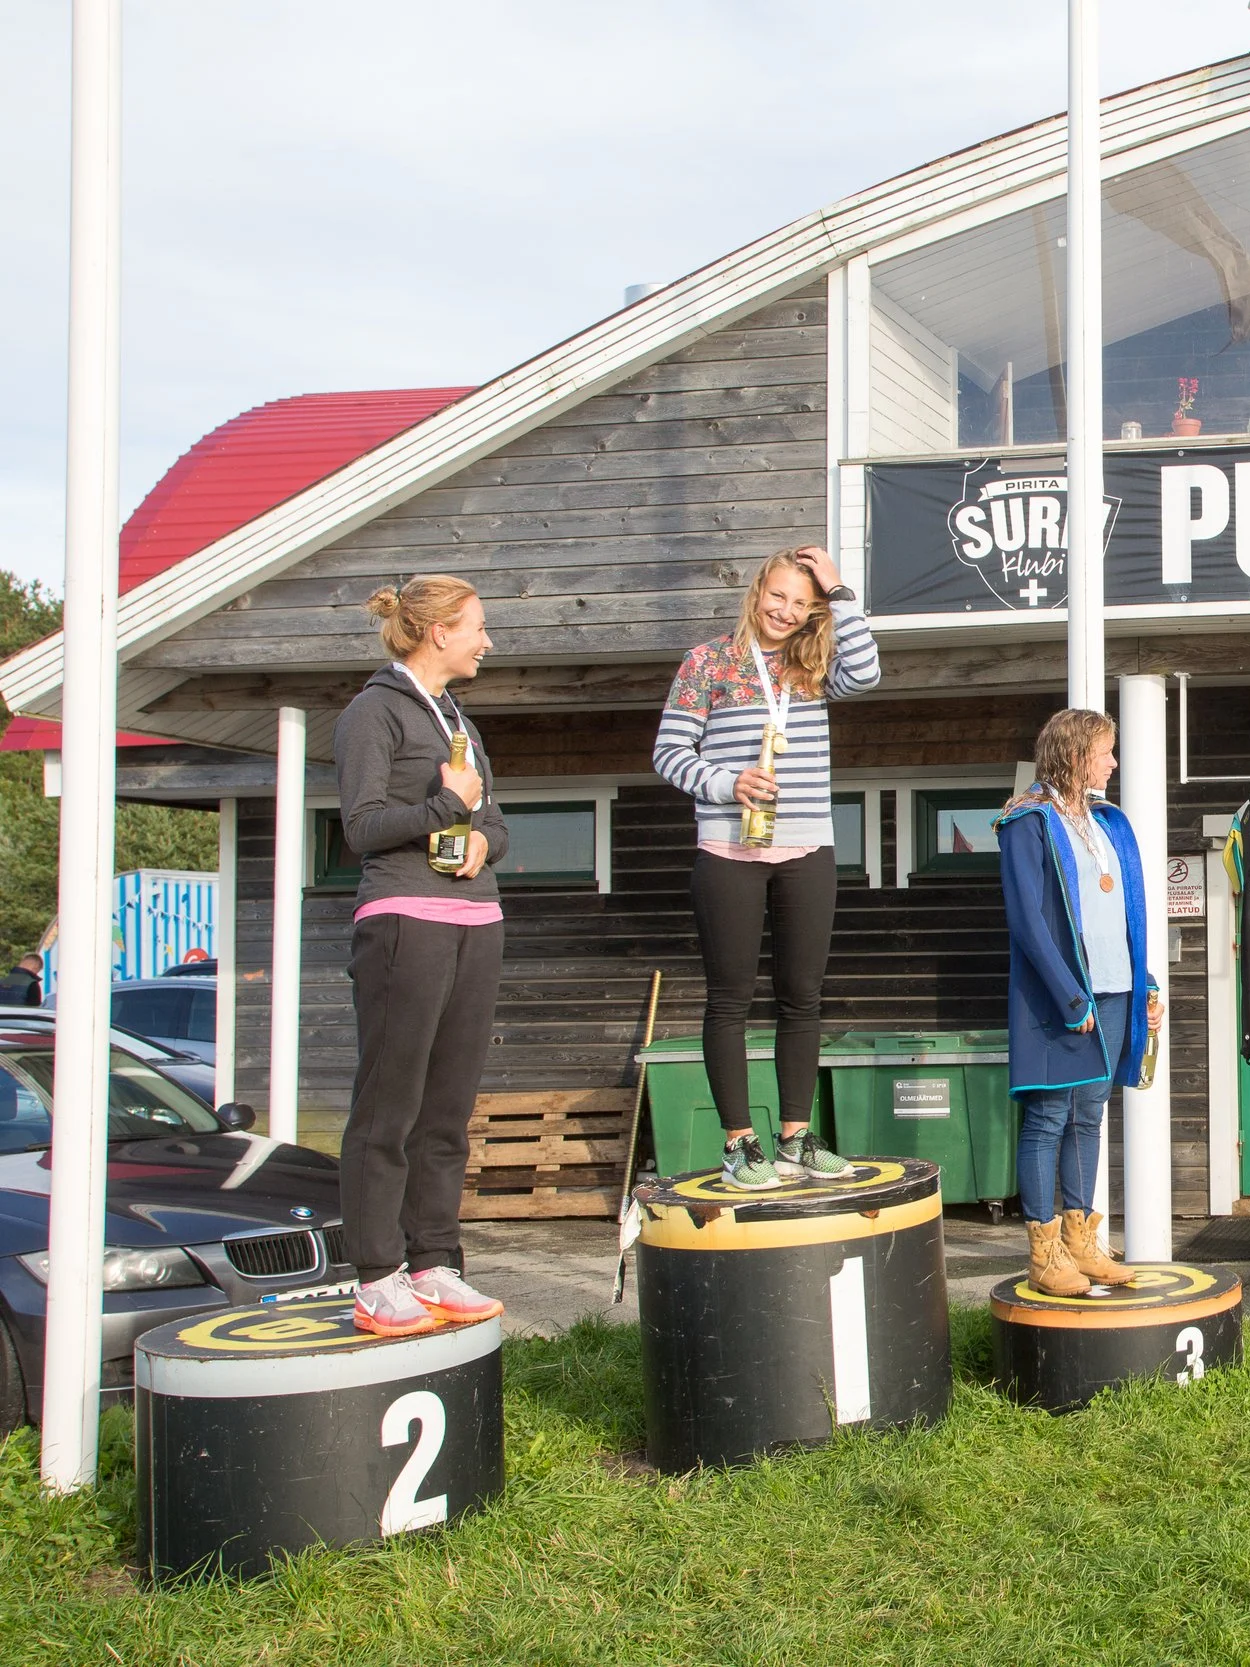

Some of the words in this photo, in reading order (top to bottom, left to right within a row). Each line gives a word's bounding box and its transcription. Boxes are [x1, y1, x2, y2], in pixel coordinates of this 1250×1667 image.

[1005, 479, 1060, 491] PIRITA
[829, 1256, 871, 1426] 1
[1175, 1326, 1205, 1388] 3
[380, 1390, 448, 1537] 2
